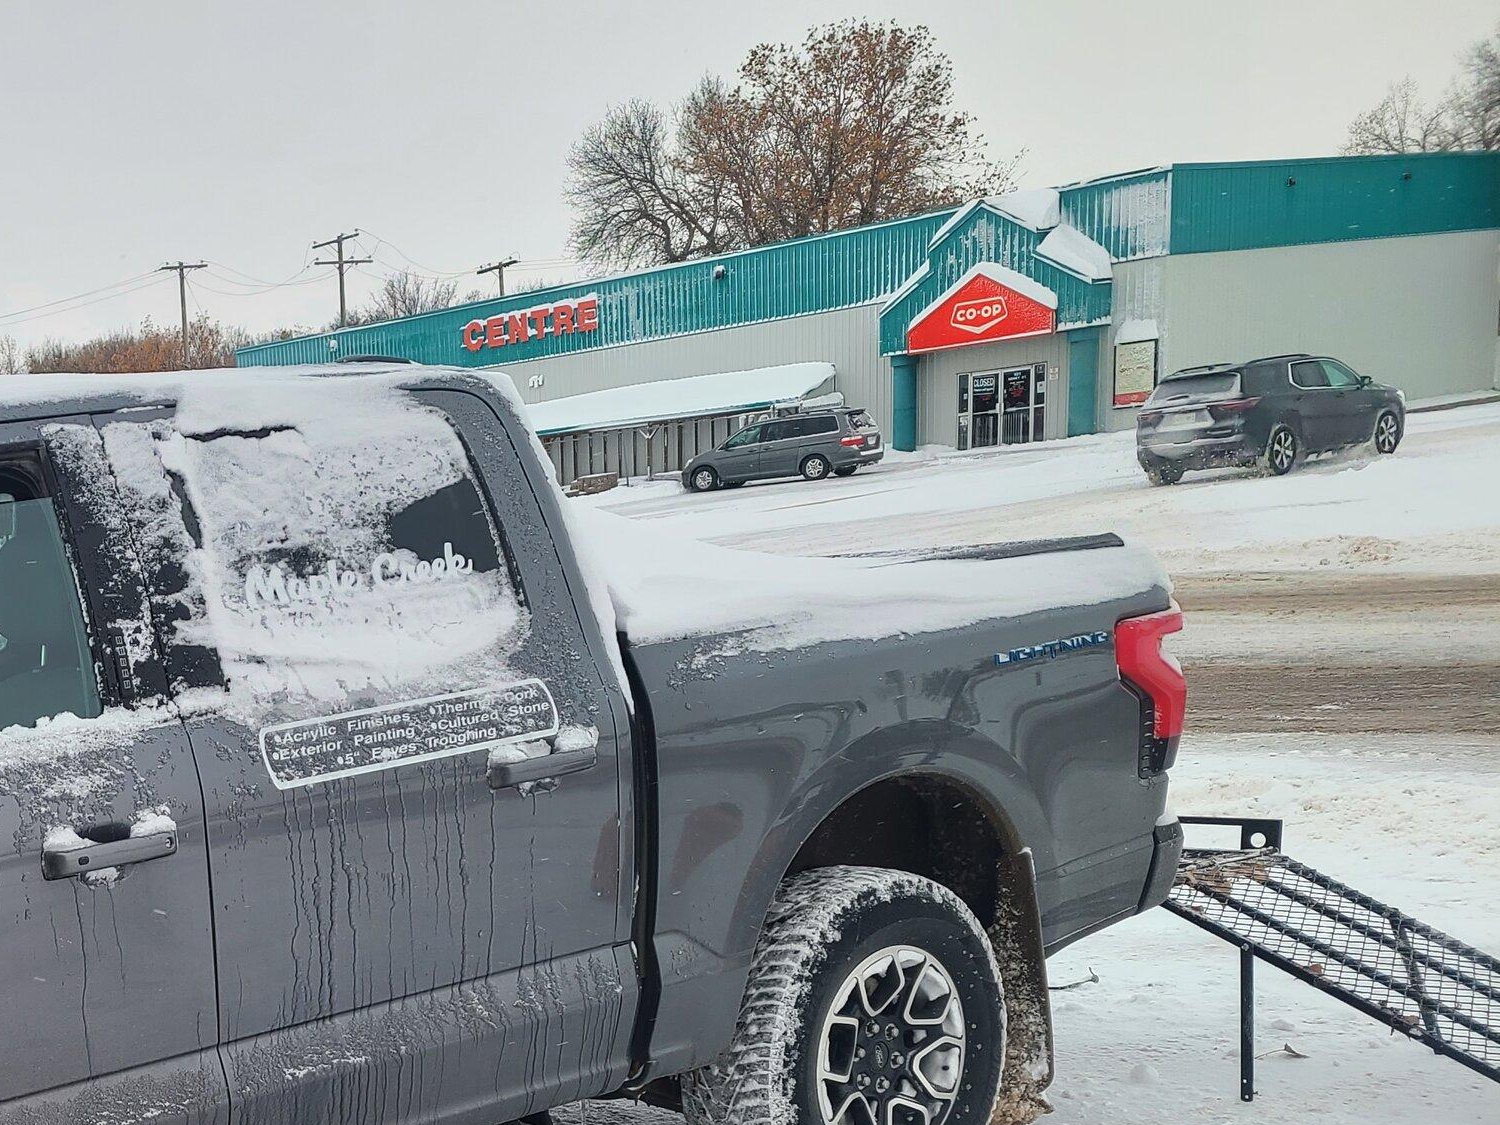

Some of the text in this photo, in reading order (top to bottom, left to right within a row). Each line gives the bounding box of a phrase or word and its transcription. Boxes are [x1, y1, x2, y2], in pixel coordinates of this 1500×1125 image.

[463, 299, 597, 351] CENTRE
[956, 304, 1002, 321] CO-OP
[973, 377, 994, 388] CLOSED
[994, 631, 1108, 666] LIGHTNING
[504, 688, 539, 702] Cork
[283, 712, 411, 744] Acrylic Finishes
[437, 701, 550, 730] Cultured Stone
[280, 727, 415, 760] Exterior Painting
[372, 742, 417, 760] Eves
[425, 727, 497, 750] Troughing
